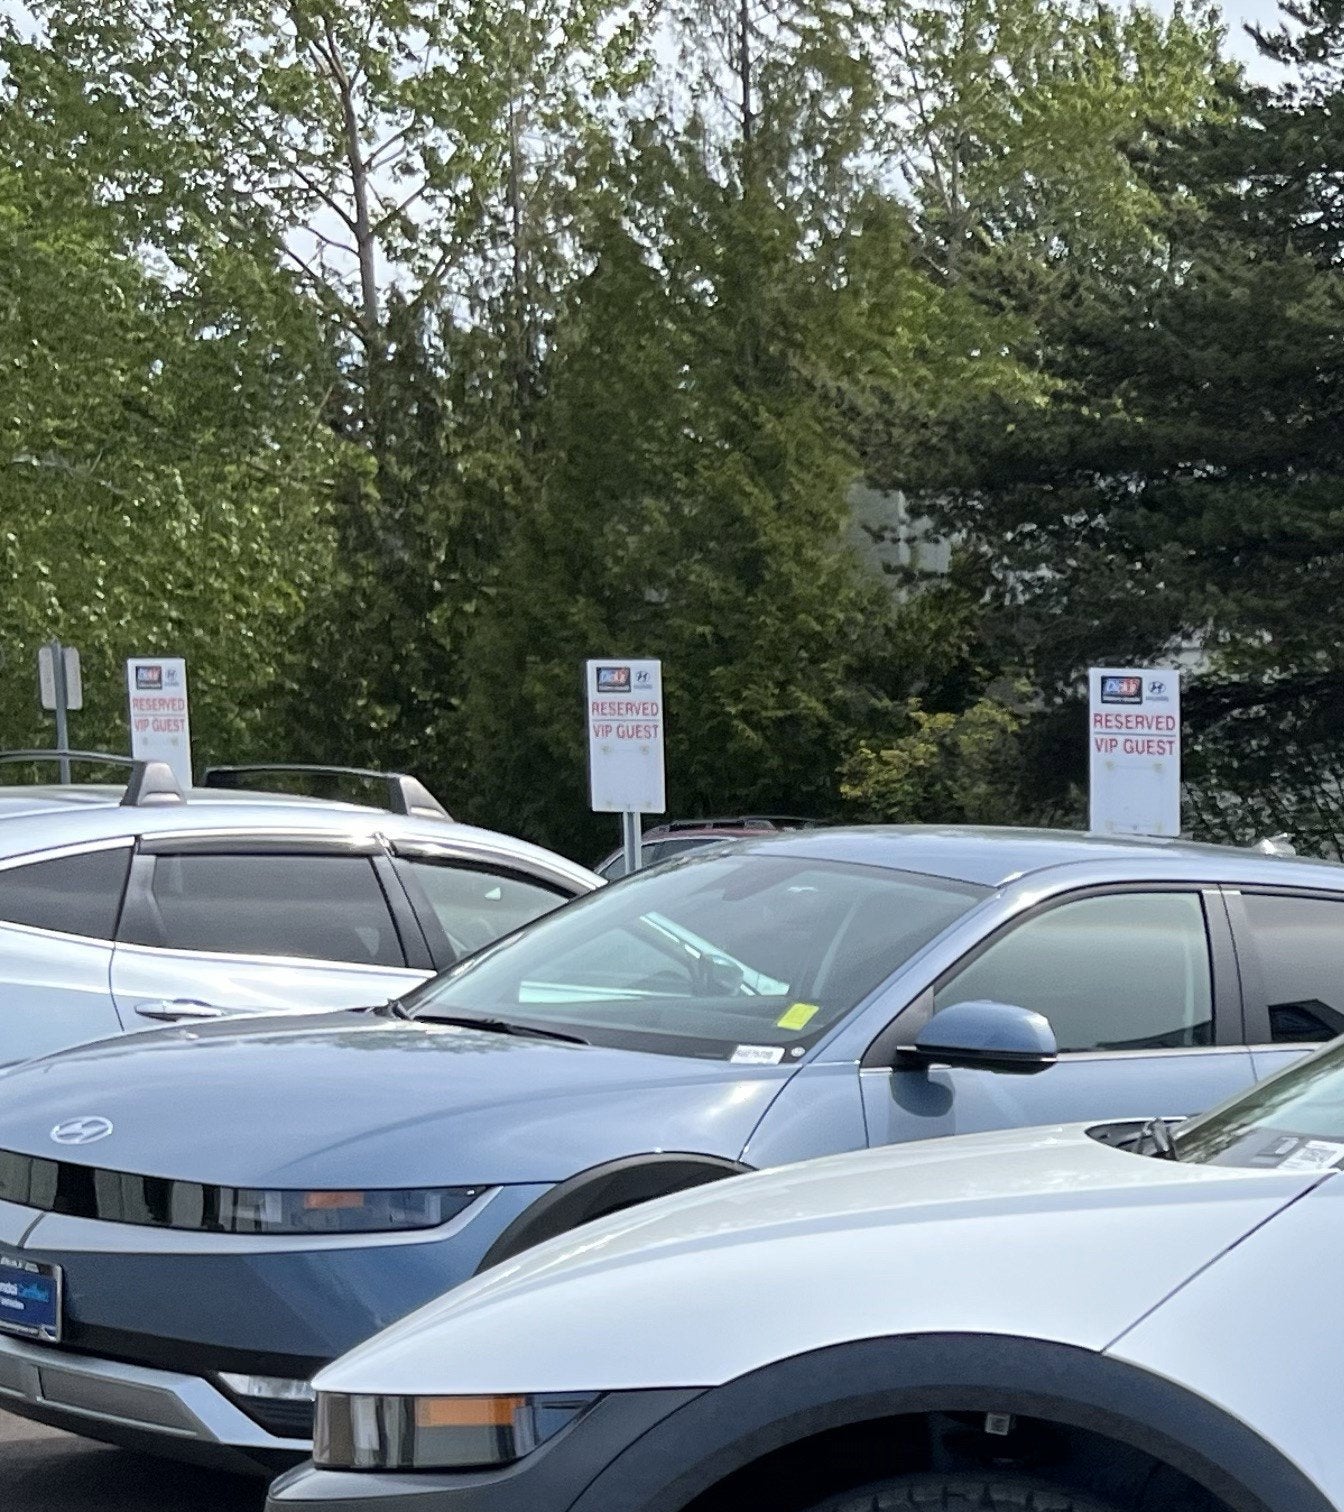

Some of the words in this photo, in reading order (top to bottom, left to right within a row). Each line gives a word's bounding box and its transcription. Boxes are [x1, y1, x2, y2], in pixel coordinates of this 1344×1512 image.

[592, 701, 659, 716] RESERVED
[1093, 713, 1176, 731] RESERVED
[593, 724, 612, 738] VIP
[617, 724, 659, 739] GUEST
[1094, 738, 1118, 753] VIP
[1123, 739, 1176, 755] GUEST
